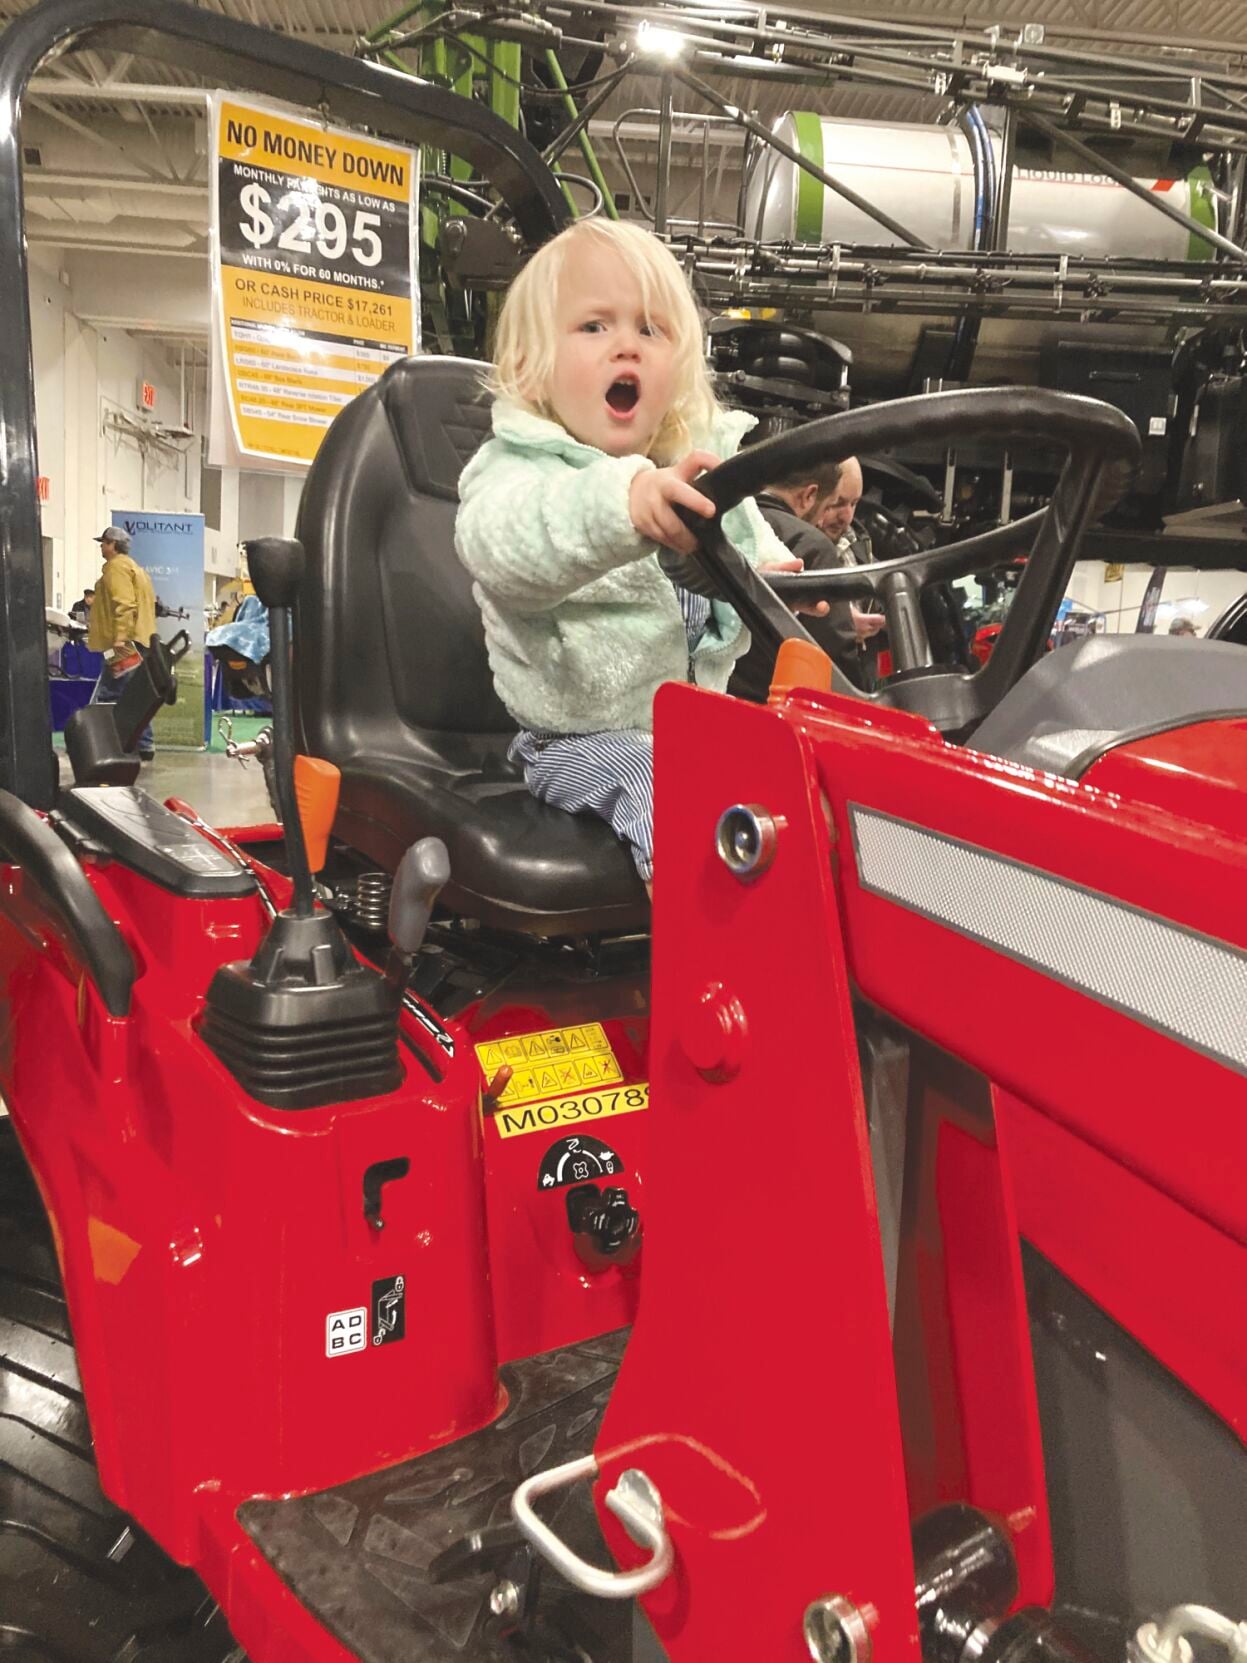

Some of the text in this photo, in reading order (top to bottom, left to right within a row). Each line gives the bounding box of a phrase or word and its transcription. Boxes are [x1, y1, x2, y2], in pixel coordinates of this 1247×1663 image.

[227, 119, 404, 186] NO MONEY DOWN
[233, 164, 396, 212] MONTHLY PAENTS AS LOW AS
[238, 182, 383, 267] $295
[242, 253, 272, 270] WITH
[274, 259, 291, 273] 0%
[293, 264, 316, 278] FOR
[318, 268, 331, 281] 60
[235, 278, 394, 318] OR CASH PRICE $17,261
[242, 296, 396, 332] INCLUDES TRACTOR & LOADER
[124, 520, 193, 536] VOLITANT
[503, 1087, 649, 1133] M03078
